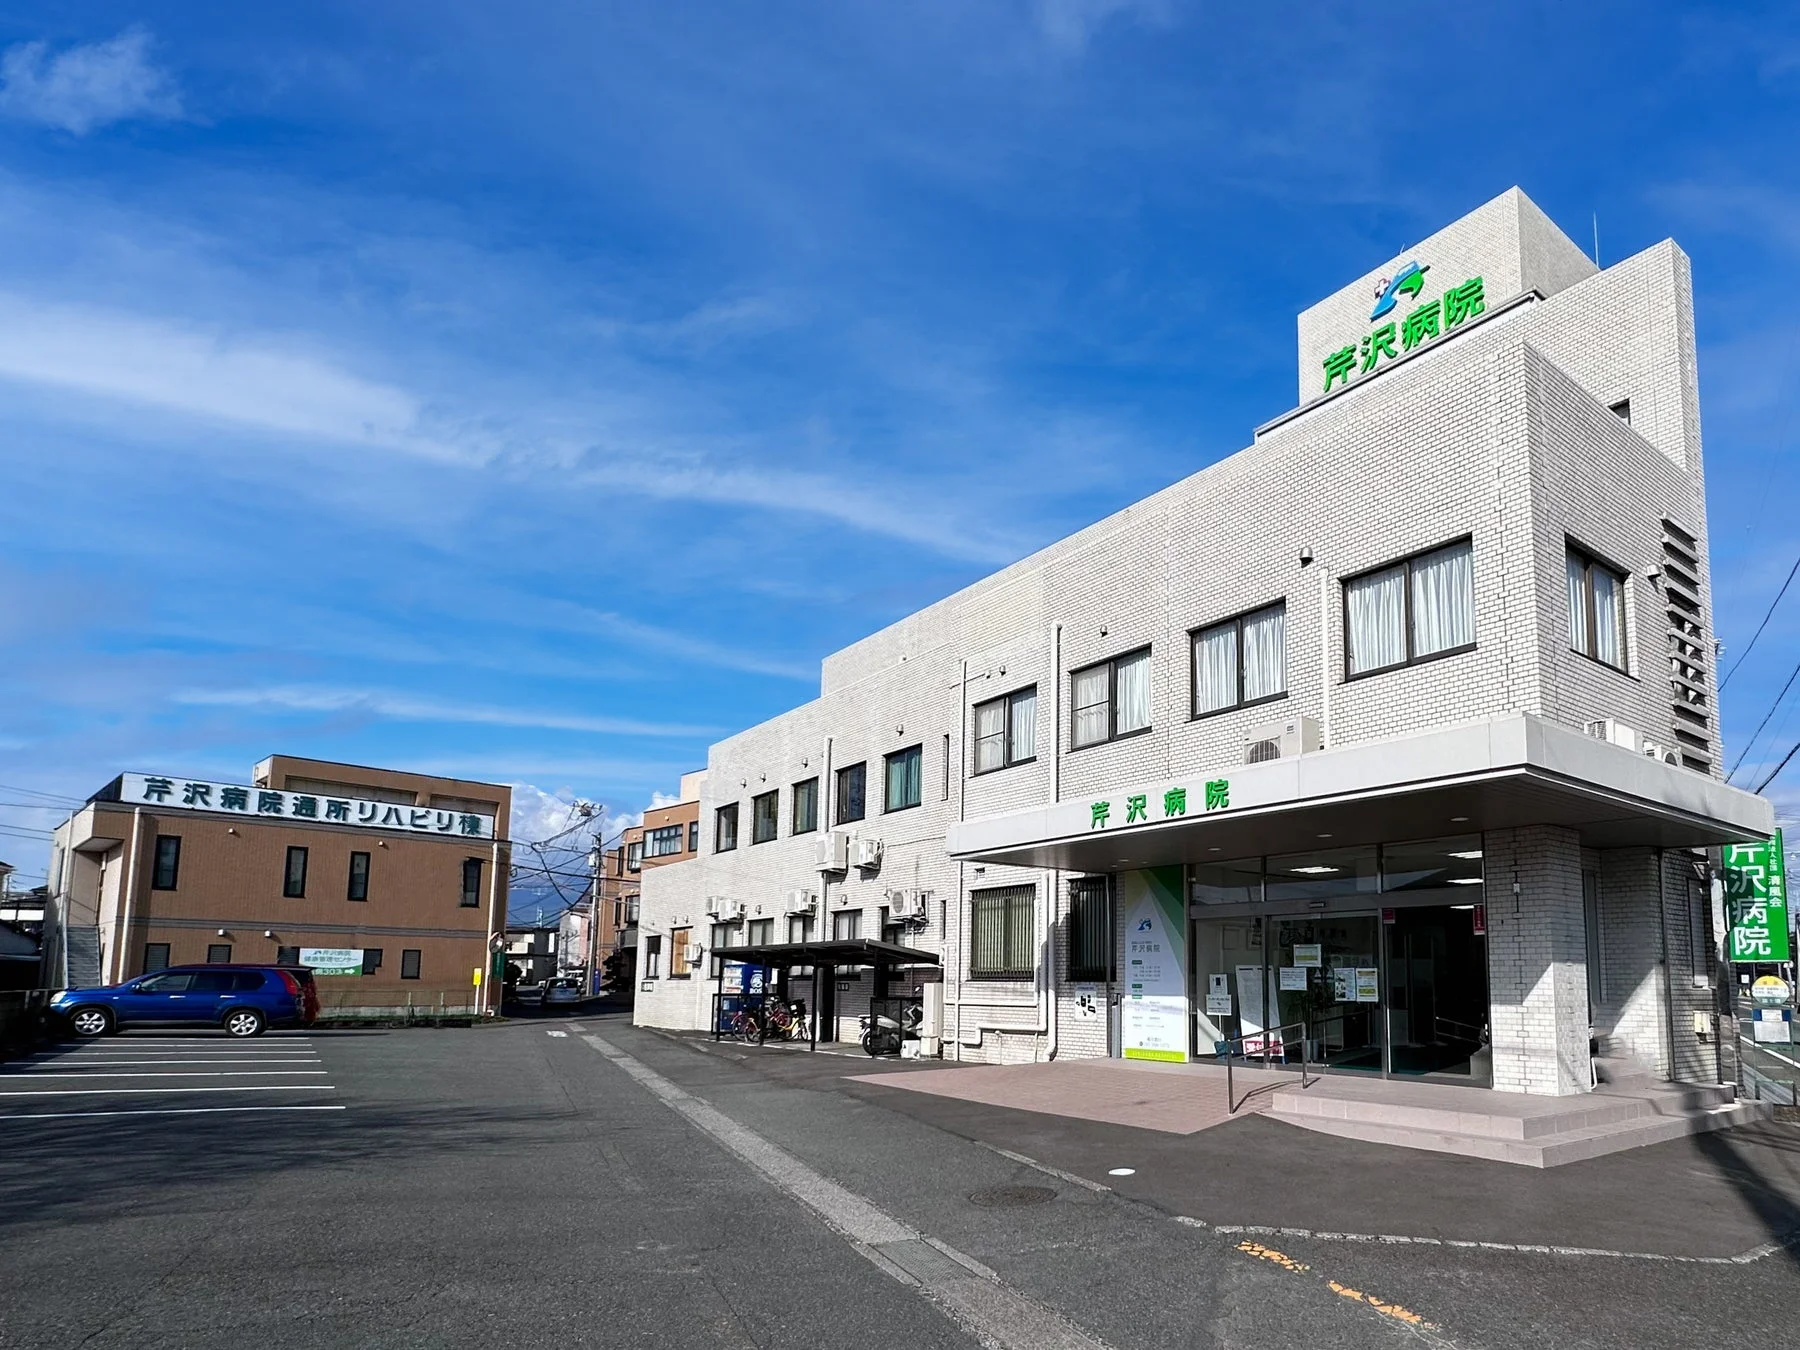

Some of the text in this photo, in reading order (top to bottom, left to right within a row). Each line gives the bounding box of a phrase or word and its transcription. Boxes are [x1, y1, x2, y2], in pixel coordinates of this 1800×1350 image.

[1322, 275, 1486, 393] 芹沢病院
[142, 777, 483, 836] 芹沢病院通所リハビリ棟
[1090, 778, 1230, 829] 芹沢病院
[1729, 842, 1772, 957] 芹沢病院
